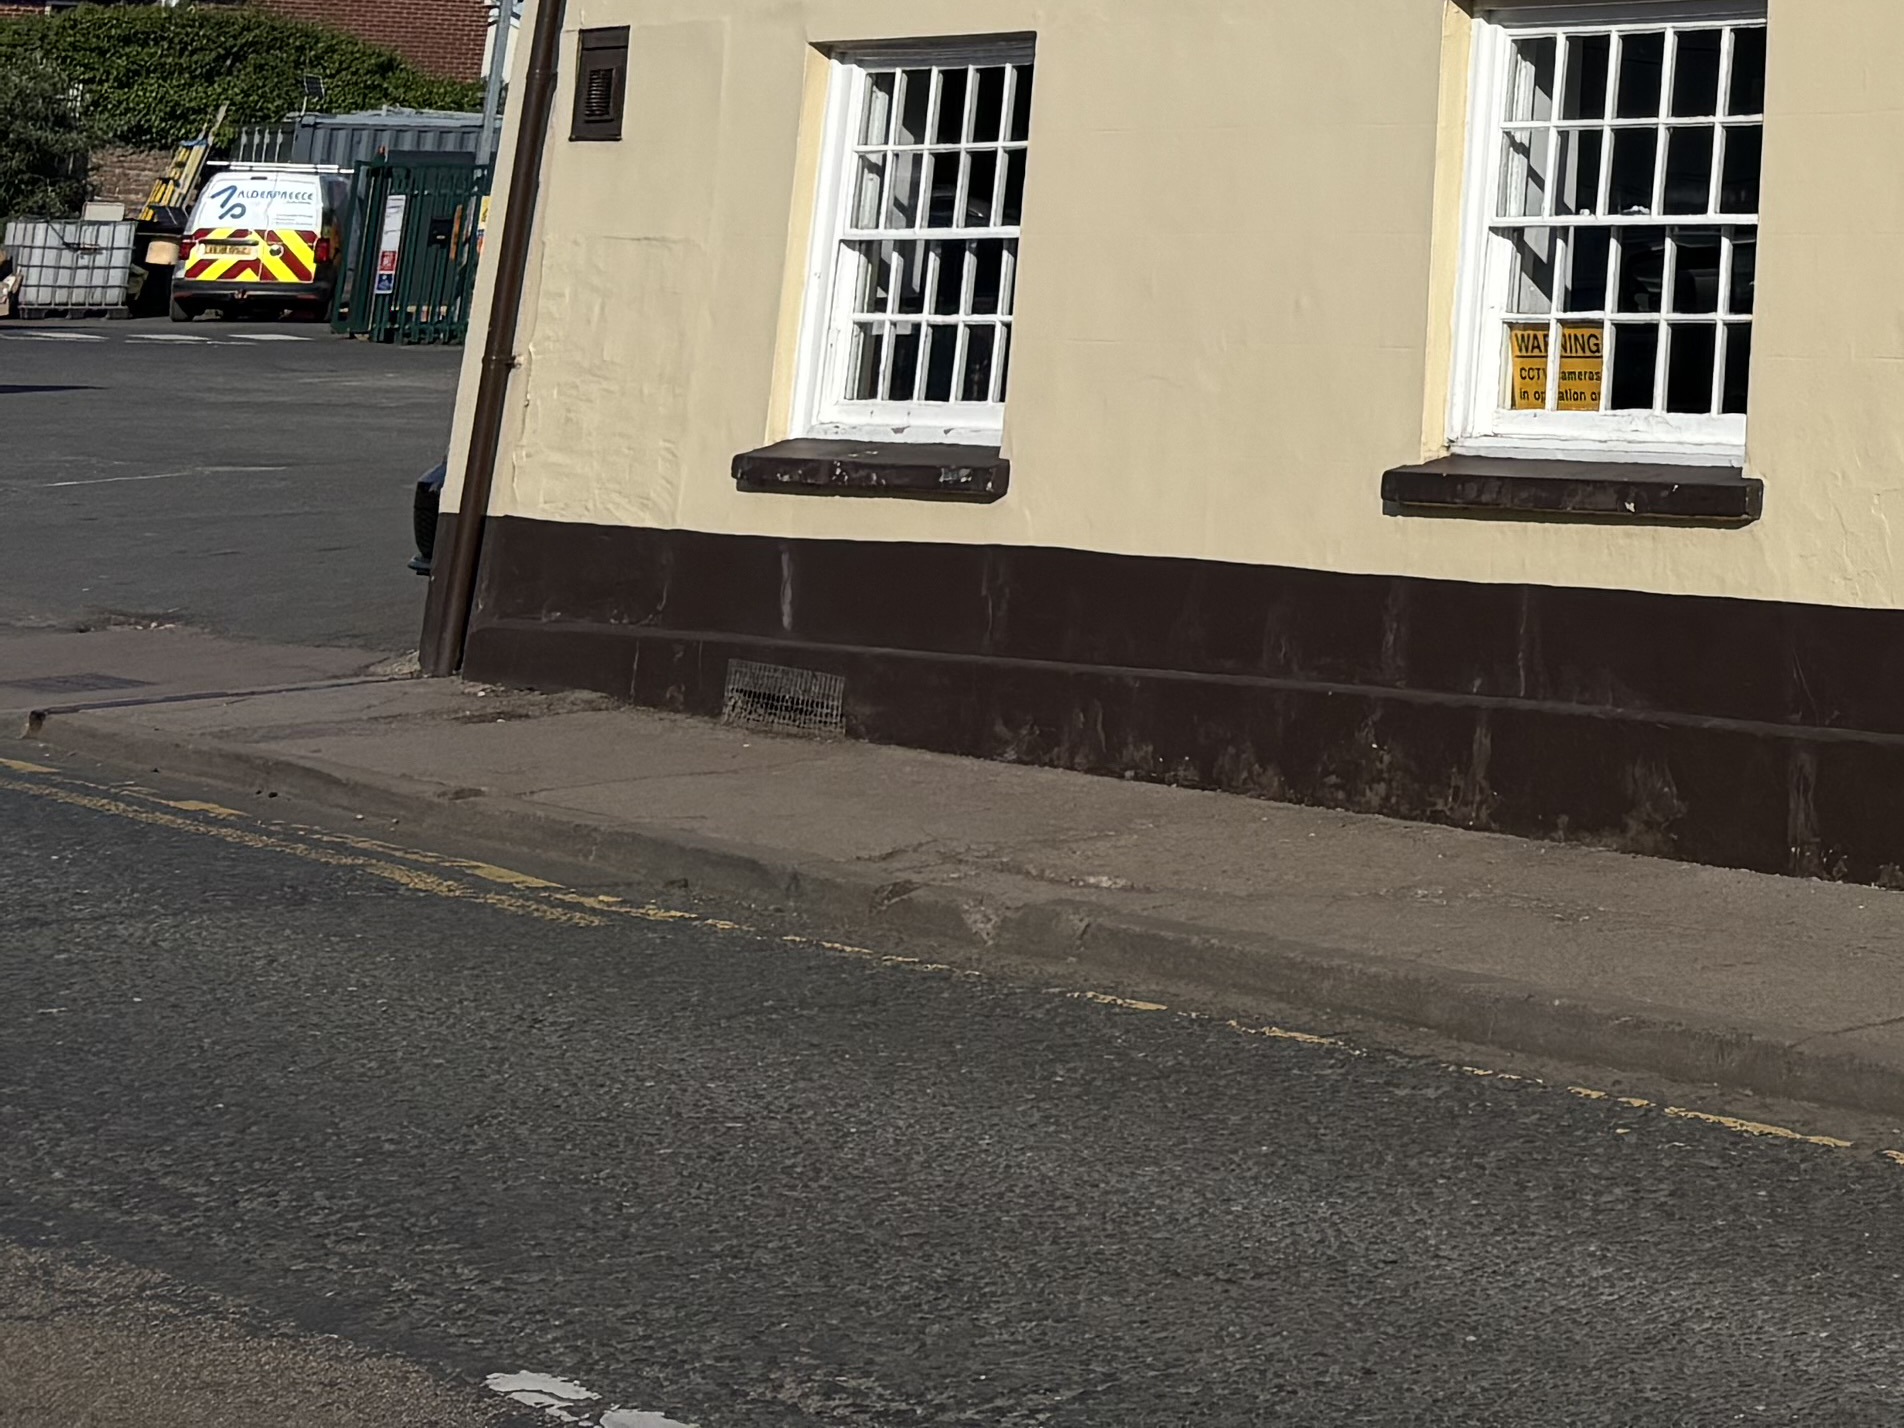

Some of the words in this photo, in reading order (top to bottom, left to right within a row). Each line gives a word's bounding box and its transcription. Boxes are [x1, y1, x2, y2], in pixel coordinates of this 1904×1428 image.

[1561, 369, 1601, 382] ameras
[1519, 388, 1530, 401] in
[1533, 388, 1587, 404] opation
